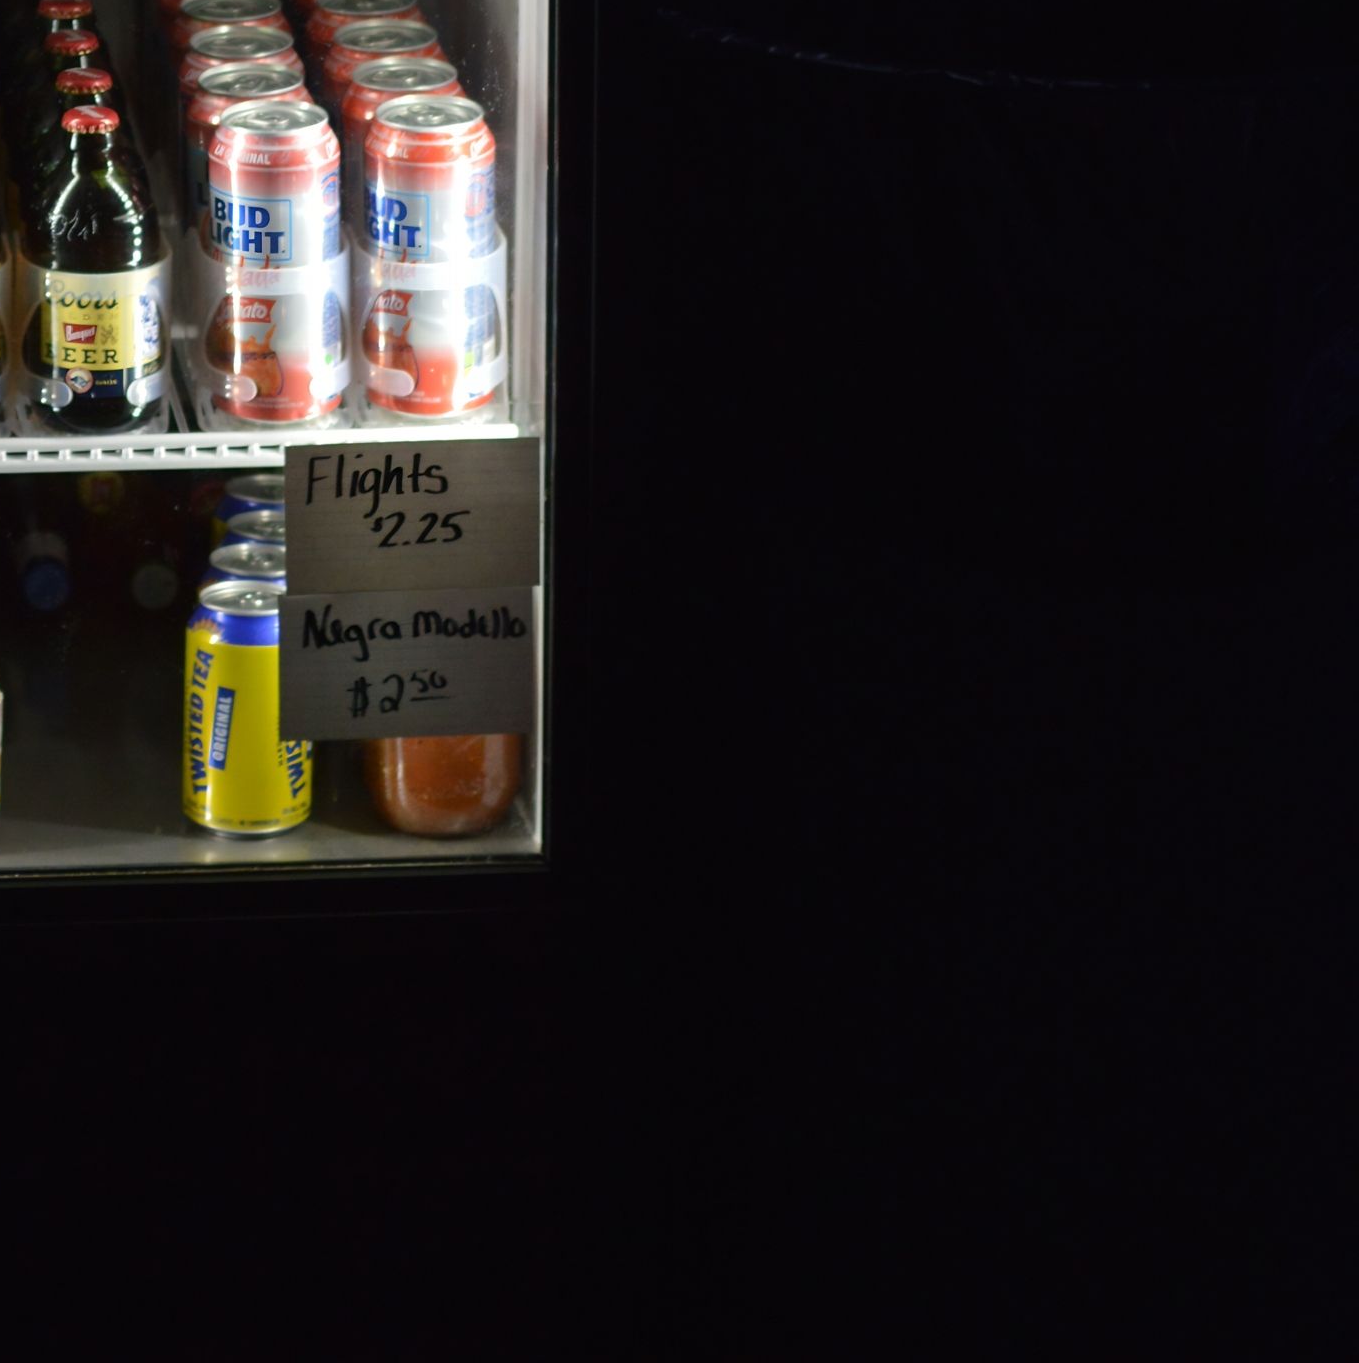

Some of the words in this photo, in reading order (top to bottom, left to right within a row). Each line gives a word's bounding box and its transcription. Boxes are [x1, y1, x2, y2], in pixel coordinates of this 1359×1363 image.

[214, 196, 271, 229] BUD
[210, 222, 286, 255] LIGHT
[305, 452, 449, 519] Flights
[370, 509, 471, 549] $2.25
[302, 603, 403, 663] Negra
[191, 648, 216, 691] TEA
[189, 691, 209, 796] TWISTED
[211, 695, 234, 762] ORIGINAL
